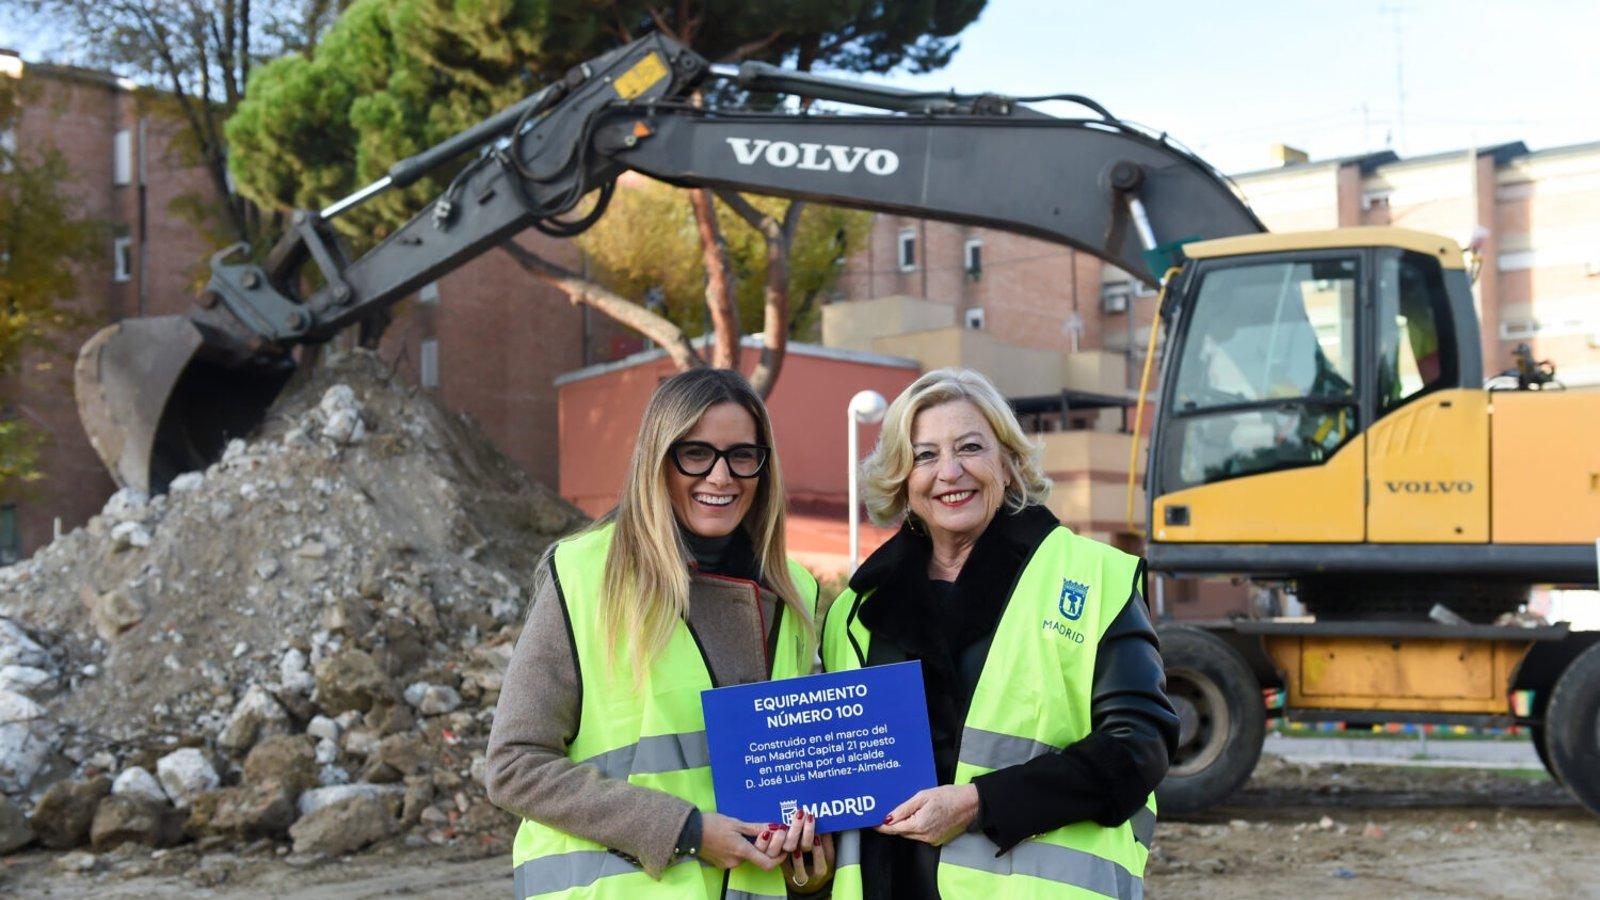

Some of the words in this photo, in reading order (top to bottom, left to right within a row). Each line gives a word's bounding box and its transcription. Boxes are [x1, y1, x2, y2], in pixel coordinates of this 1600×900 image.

[726, 137, 900, 176] VOLVO
[1384, 481, 1474, 494] VOLVO
[1042, 620, 1085, 644] MADRID
[754, 684, 868, 712] EQUIPAMIENTO
[766, 707, 833, 729] NÚMERO
[835, 703, 864, 719] 100
[745, 754, 767, 765] Plan
[768, 747, 805, 762] Madrid
[807, 741, 845, 757] Capital
[846, 740, 858, 751] 21
[859, 736, 896, 751] puesto
[749, 736, 807, 752] Construido
[809, 735, 823, 744] en
[824, 731, 834, 742] el
[836, 728, 869, 740] marco
[871, 723, 888, 735] del
[745, 779, 756, 789] D.
[758, 774, 783, 788] José
[784, 772, 806, 784] Luis
[807, 759, 902, 780] Martínez-Almeida.
[759, 766, 772, 775] en
[774, 759, 814, 773] marcha
[816, 757, 834, 769] por
[836, 753, 846, 764] el
[847, 749, 885, 763] alcalde
[802, 795, 876, 819] MADRID
